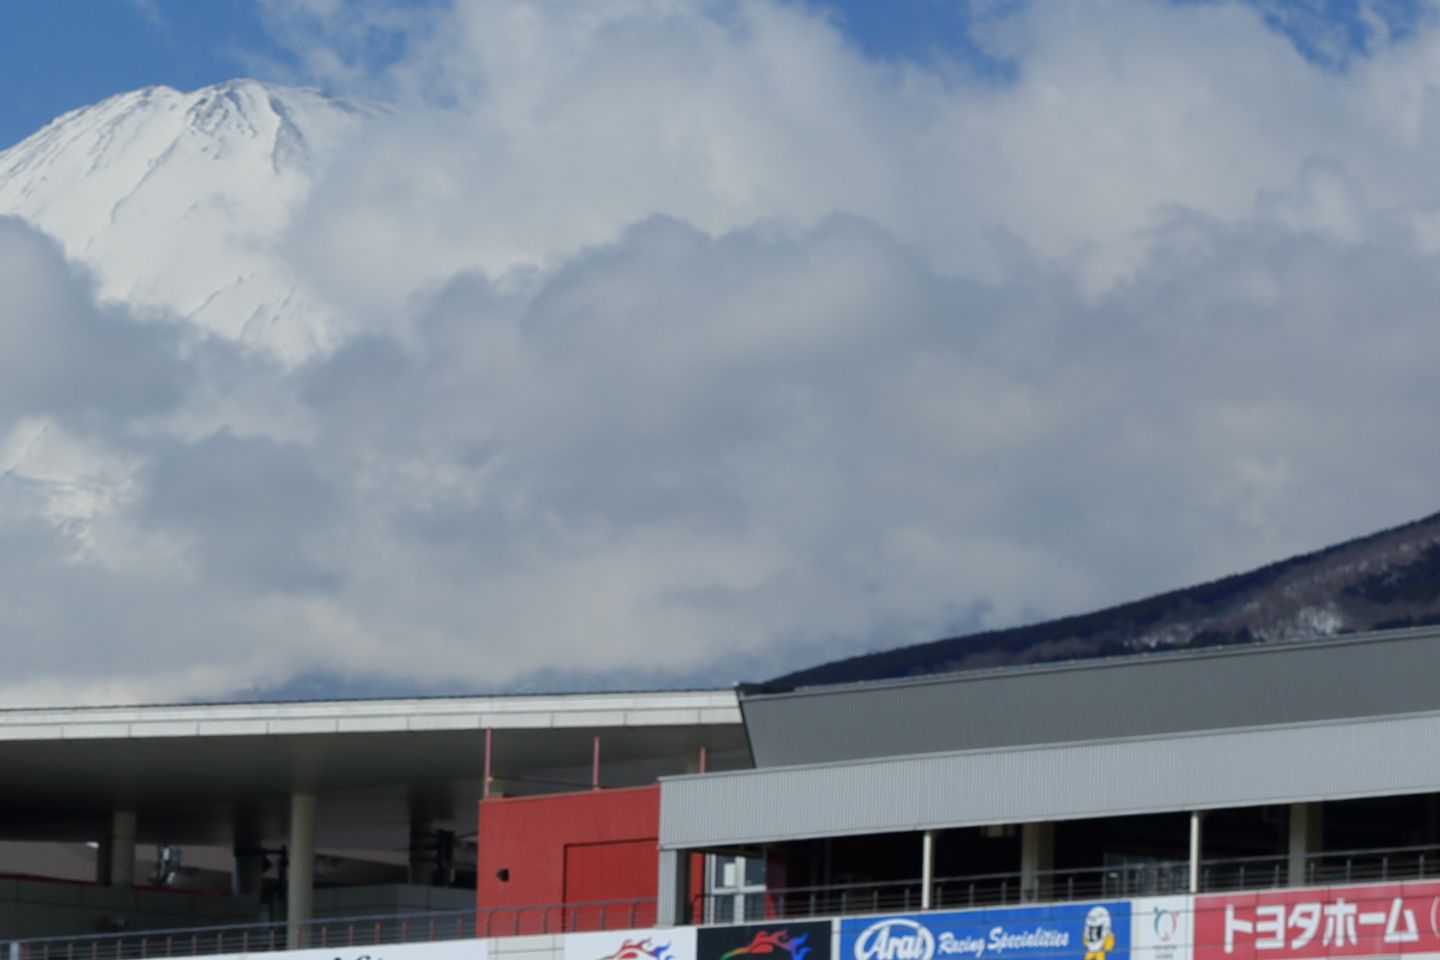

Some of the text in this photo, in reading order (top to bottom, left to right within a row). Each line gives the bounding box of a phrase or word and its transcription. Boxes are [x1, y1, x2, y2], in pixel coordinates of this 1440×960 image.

[863, 925, 926, 960] Arai
[1224, 897, 1419, 954] トヨタホーム
[938, 932, 985, 959] Racing
